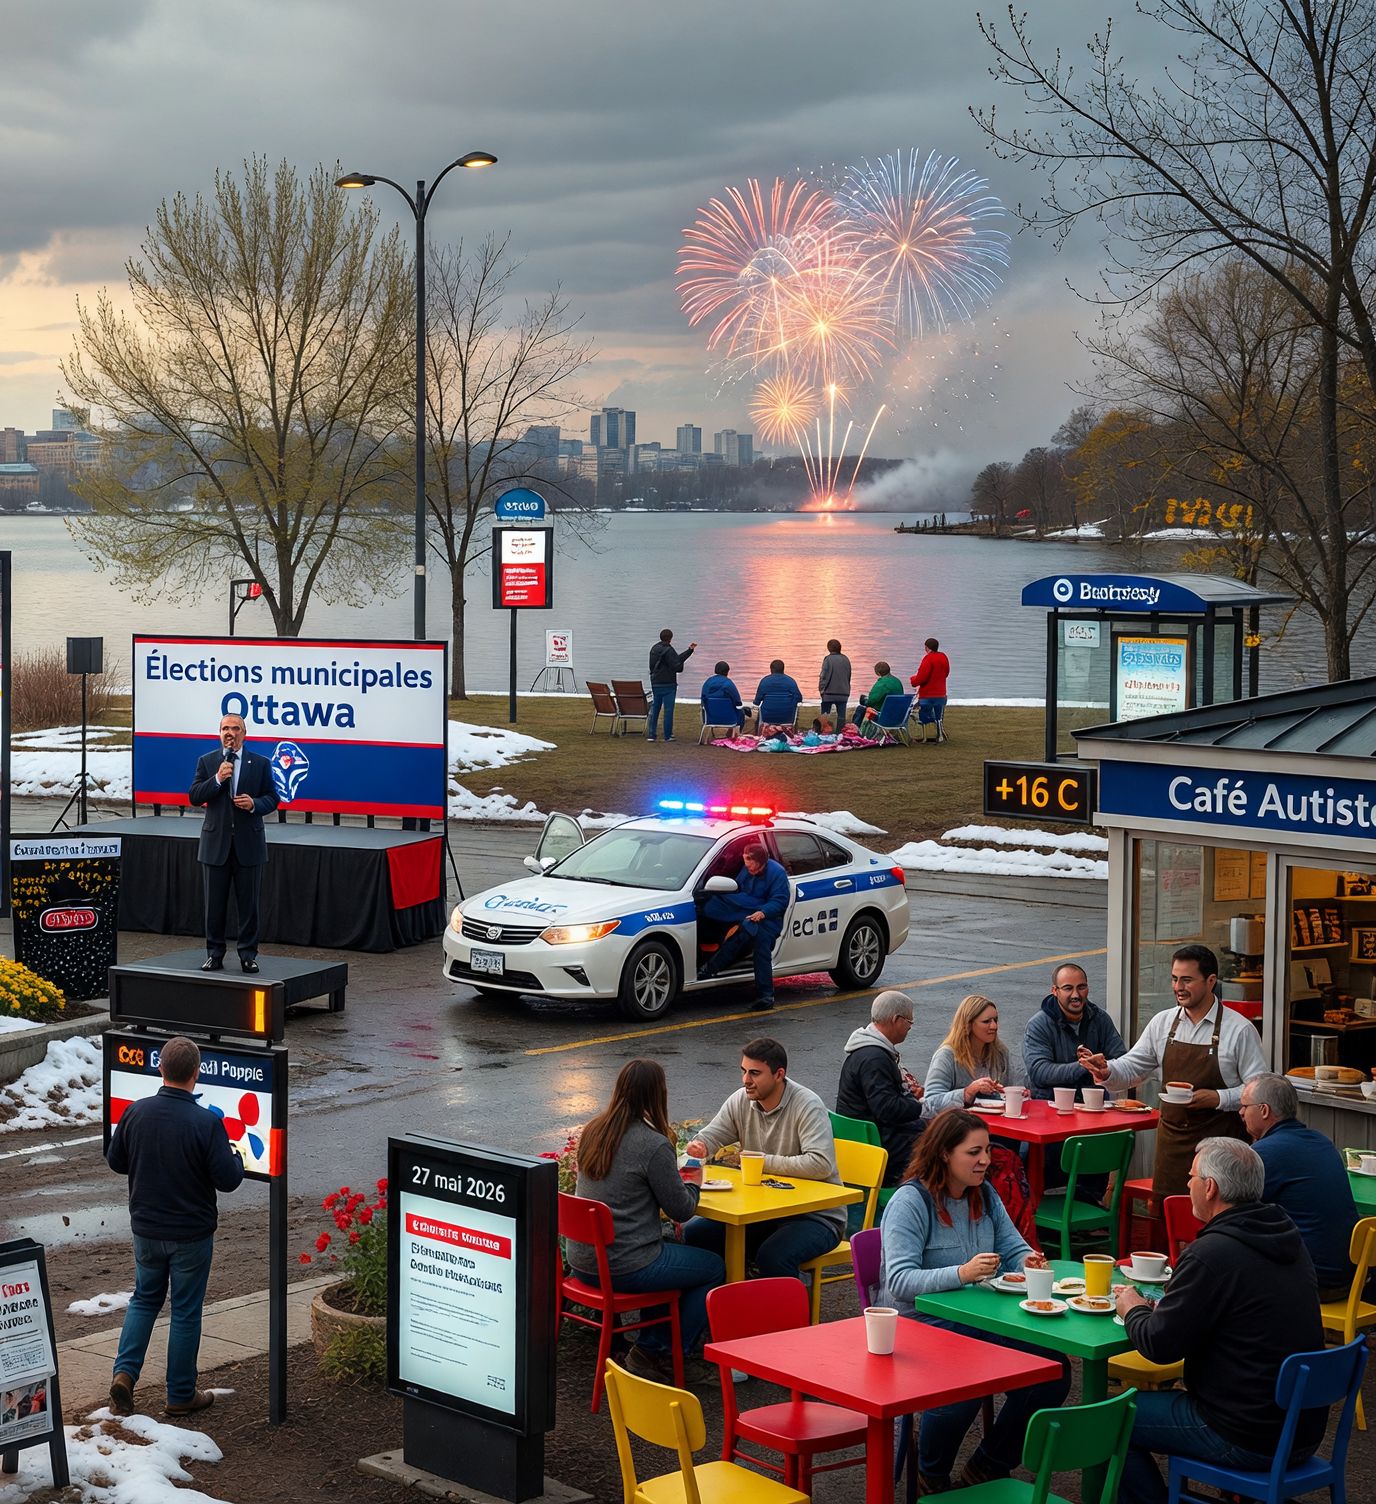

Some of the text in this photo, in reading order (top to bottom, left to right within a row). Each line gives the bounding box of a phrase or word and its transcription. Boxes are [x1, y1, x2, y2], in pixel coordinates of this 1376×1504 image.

[146, 649, 433, 693] Élections municipales
[221, 691, 355, 728] Ottawa
[995, 775, 1079, 811] +16 C
[1168, 776, 1248, 815] Café
[412, 1165, 505, 1203] 27 mai 2026
